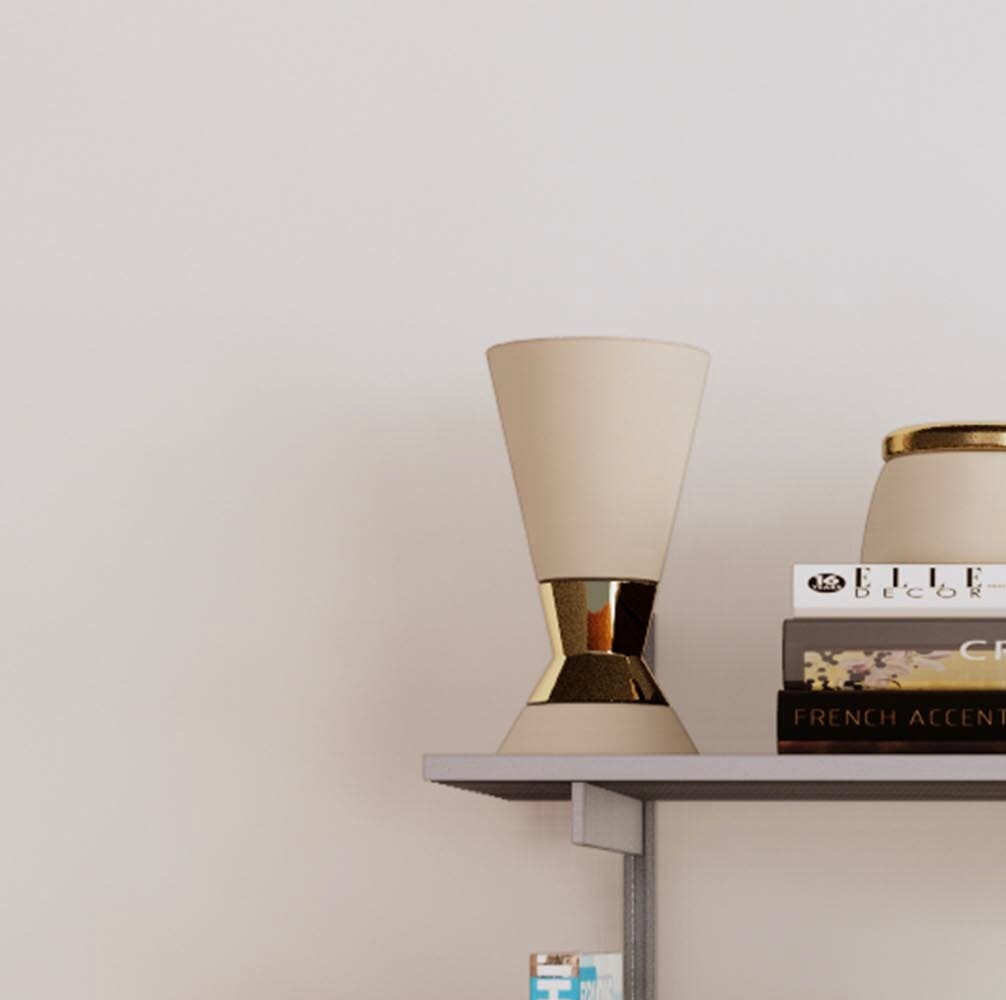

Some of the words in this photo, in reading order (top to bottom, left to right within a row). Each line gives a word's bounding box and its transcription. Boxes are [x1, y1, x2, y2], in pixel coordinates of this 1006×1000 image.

[854, 566, 984, 588] ELLE
[854, 587, 983, 599] DECOR
[793, 708, 898, 727] FRENCH
